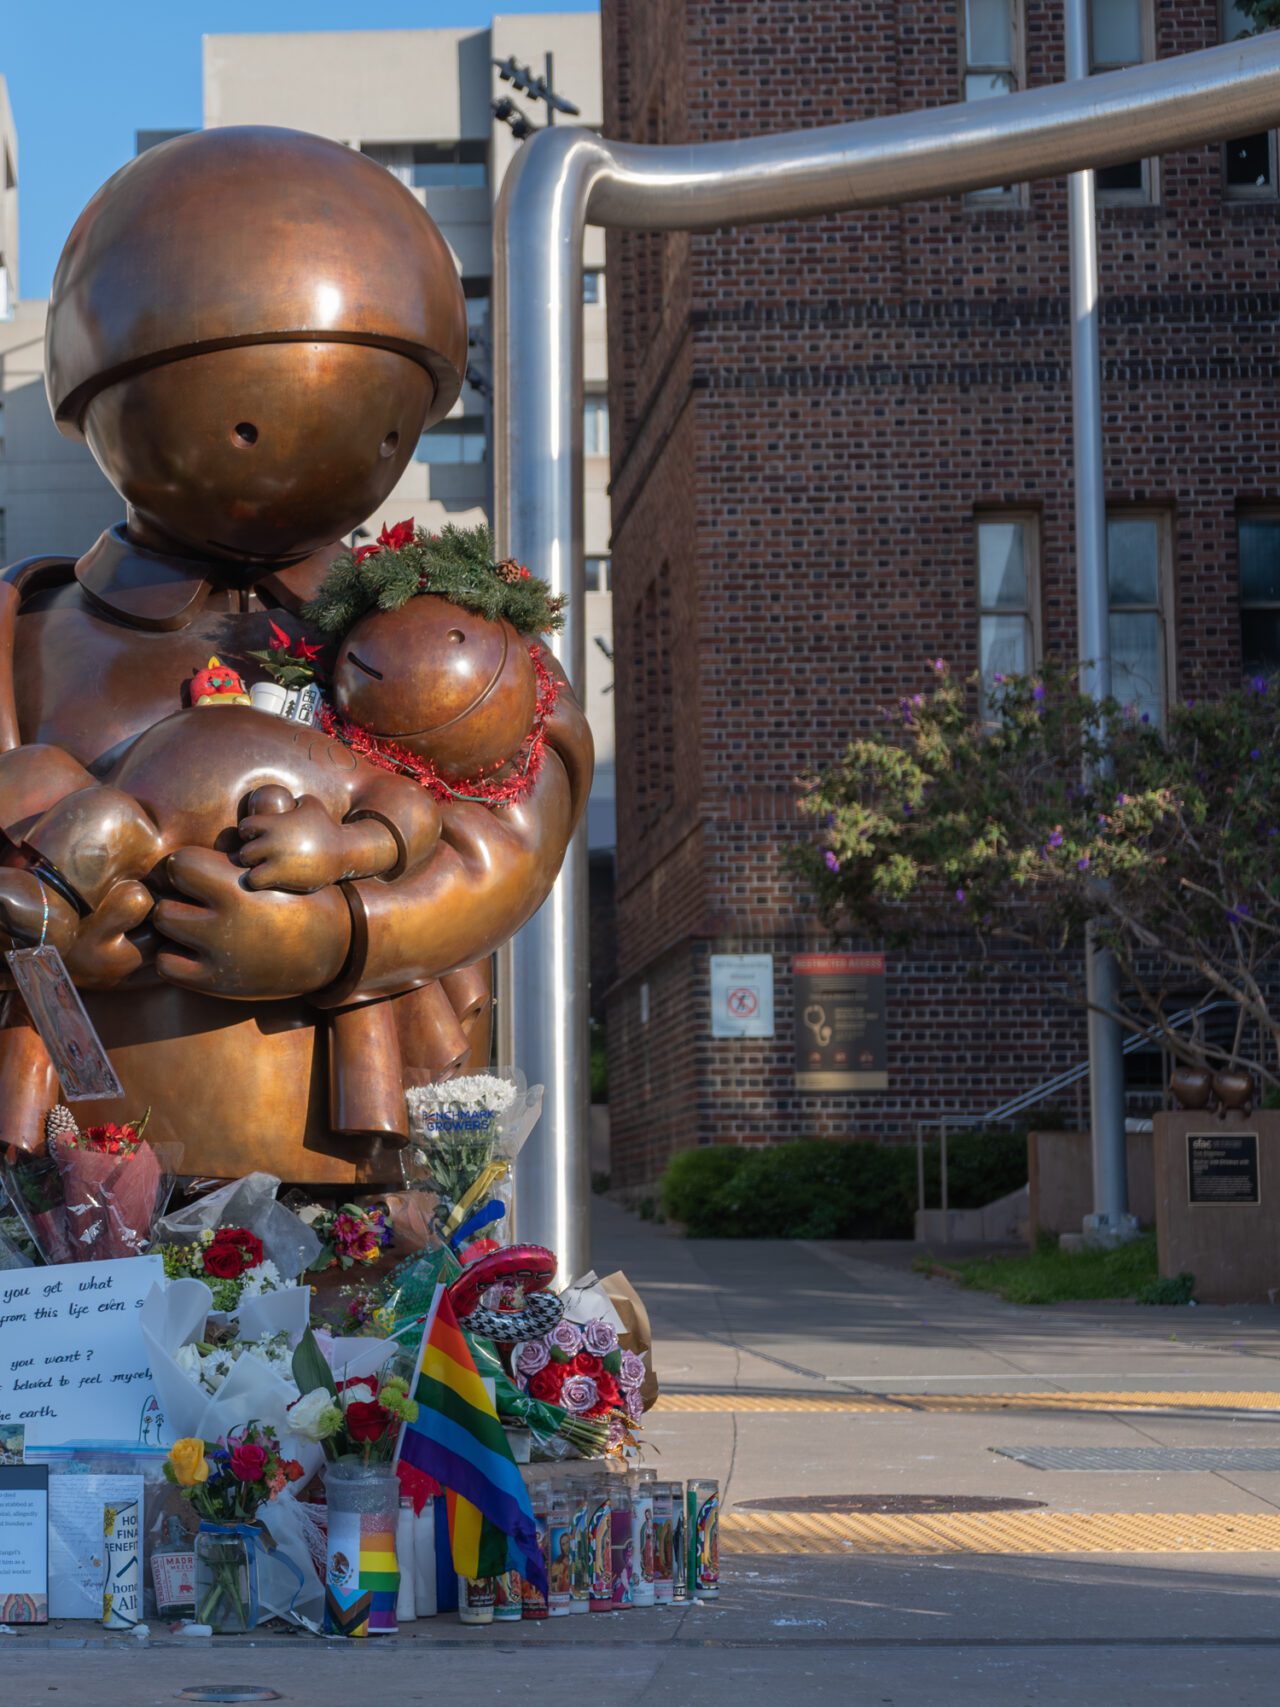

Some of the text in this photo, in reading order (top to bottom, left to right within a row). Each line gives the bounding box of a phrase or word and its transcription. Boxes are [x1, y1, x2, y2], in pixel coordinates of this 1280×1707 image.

[427, 1119, 489, 1132] GROWERS
[4, 1286, 31, 1302] you
[44, 1282, 62, 1297] get
[79, 1276, 114, 1292] what
[34, 1308, 58, 1320] this
[69, 1303, 89, 1319] life
[98, 1299, 125, 1311] even
[10, 1358, 34, 1371] you
[13, 1378, 52, 1391] beloved
[59, 1378, 69, 1386] to
[79, 1374, 102, 1388] feel
[20, 1406, 58, 1419] earth
[122, 1516, 138, 1526] HO
[117, 1529, 138, 1539] FINA
[166, 1557, 193, 1565] MADR
